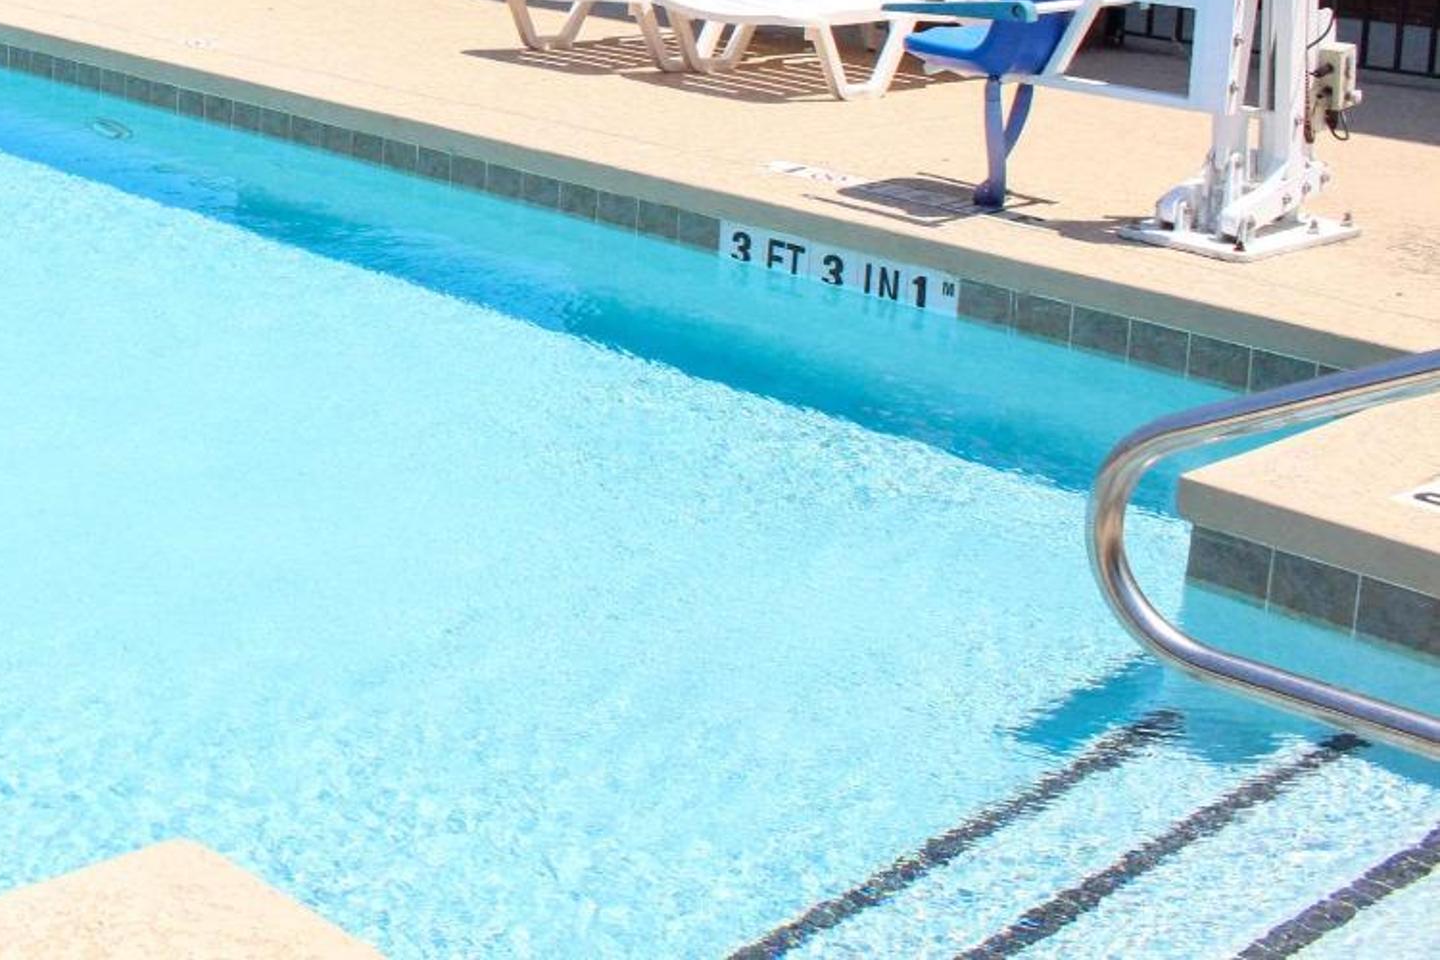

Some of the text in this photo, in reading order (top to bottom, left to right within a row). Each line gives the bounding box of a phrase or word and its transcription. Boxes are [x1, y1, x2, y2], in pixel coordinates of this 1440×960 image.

[731, 231, 752, 262] 3
[766, 237, 806, 275] FT
[821, 254, 844, 286] 3
[863, 263, 900, 300] IN
[912, 275, 928, 308] 1
